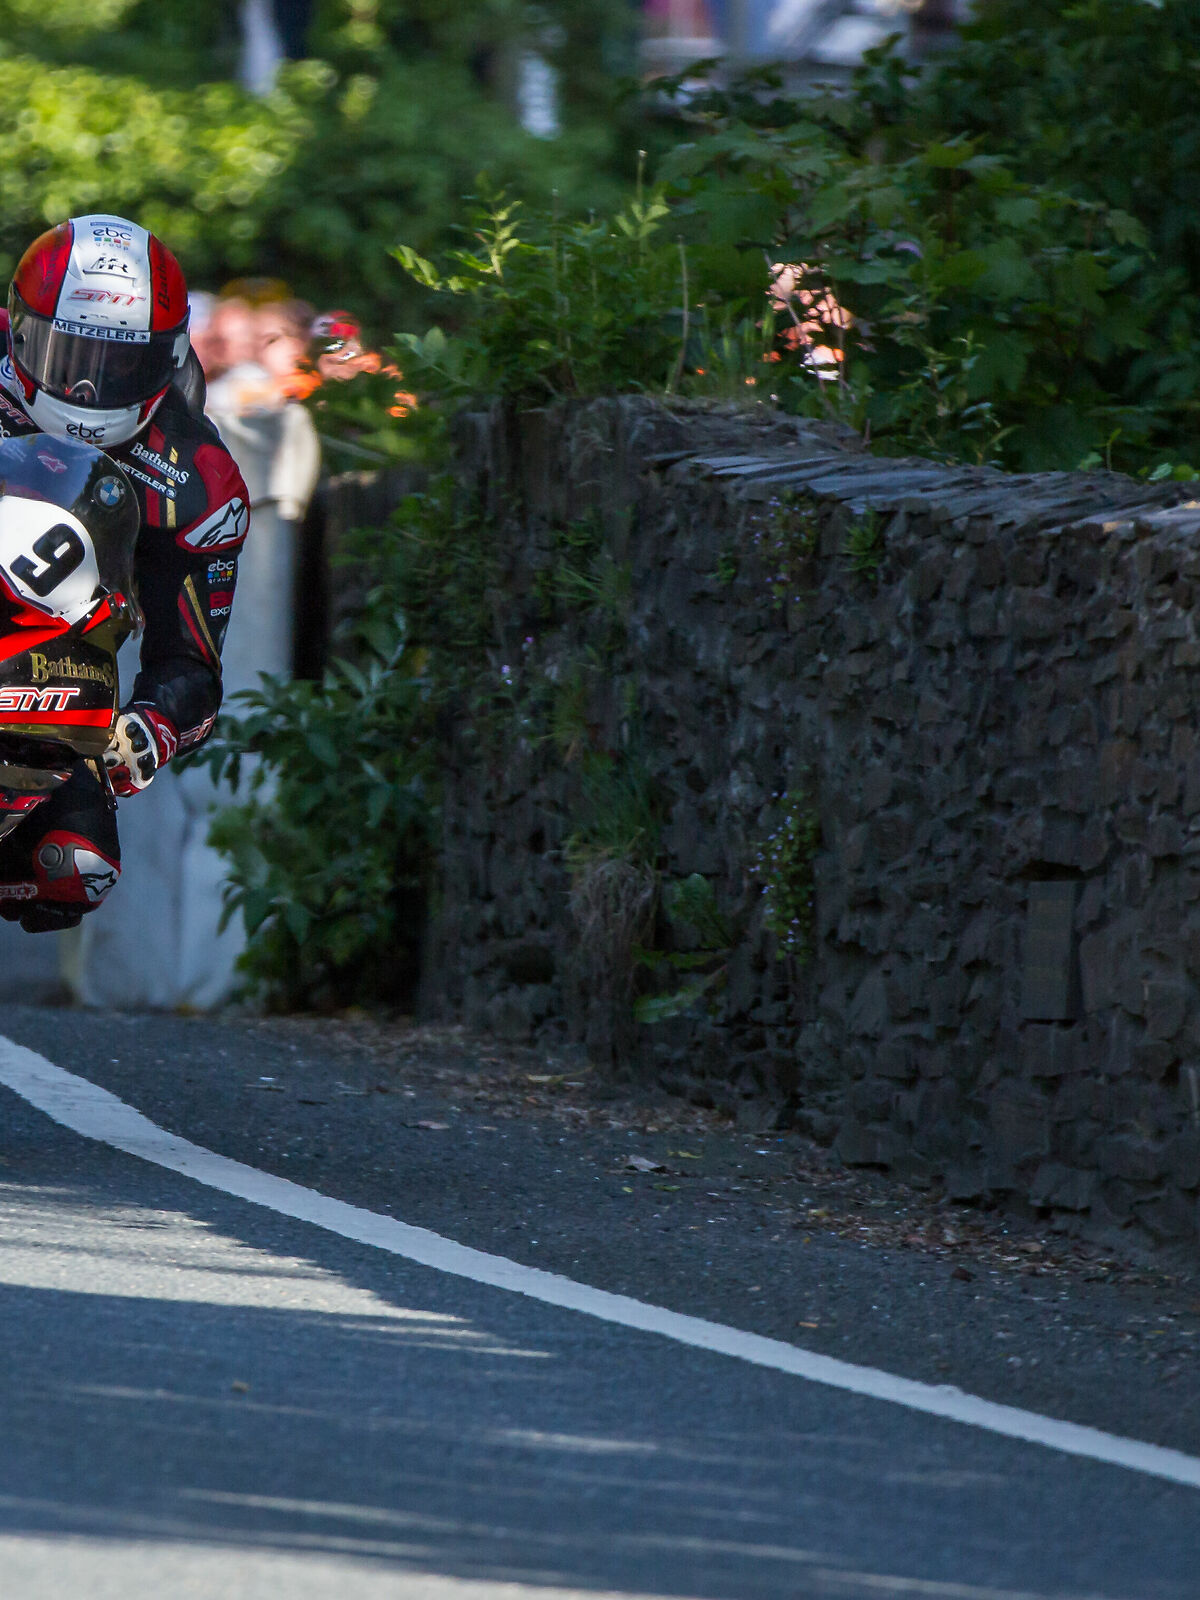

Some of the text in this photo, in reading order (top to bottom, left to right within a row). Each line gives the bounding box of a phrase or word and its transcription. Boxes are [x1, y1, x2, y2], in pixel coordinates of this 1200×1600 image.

[93, 227, 132, 241] ebc
[54, 321, 136, 341] METZELER
[66, 423, 106, 439] ebc
[9, 523, 86, 598] 9
[207, 559, 235, 572] ebc
